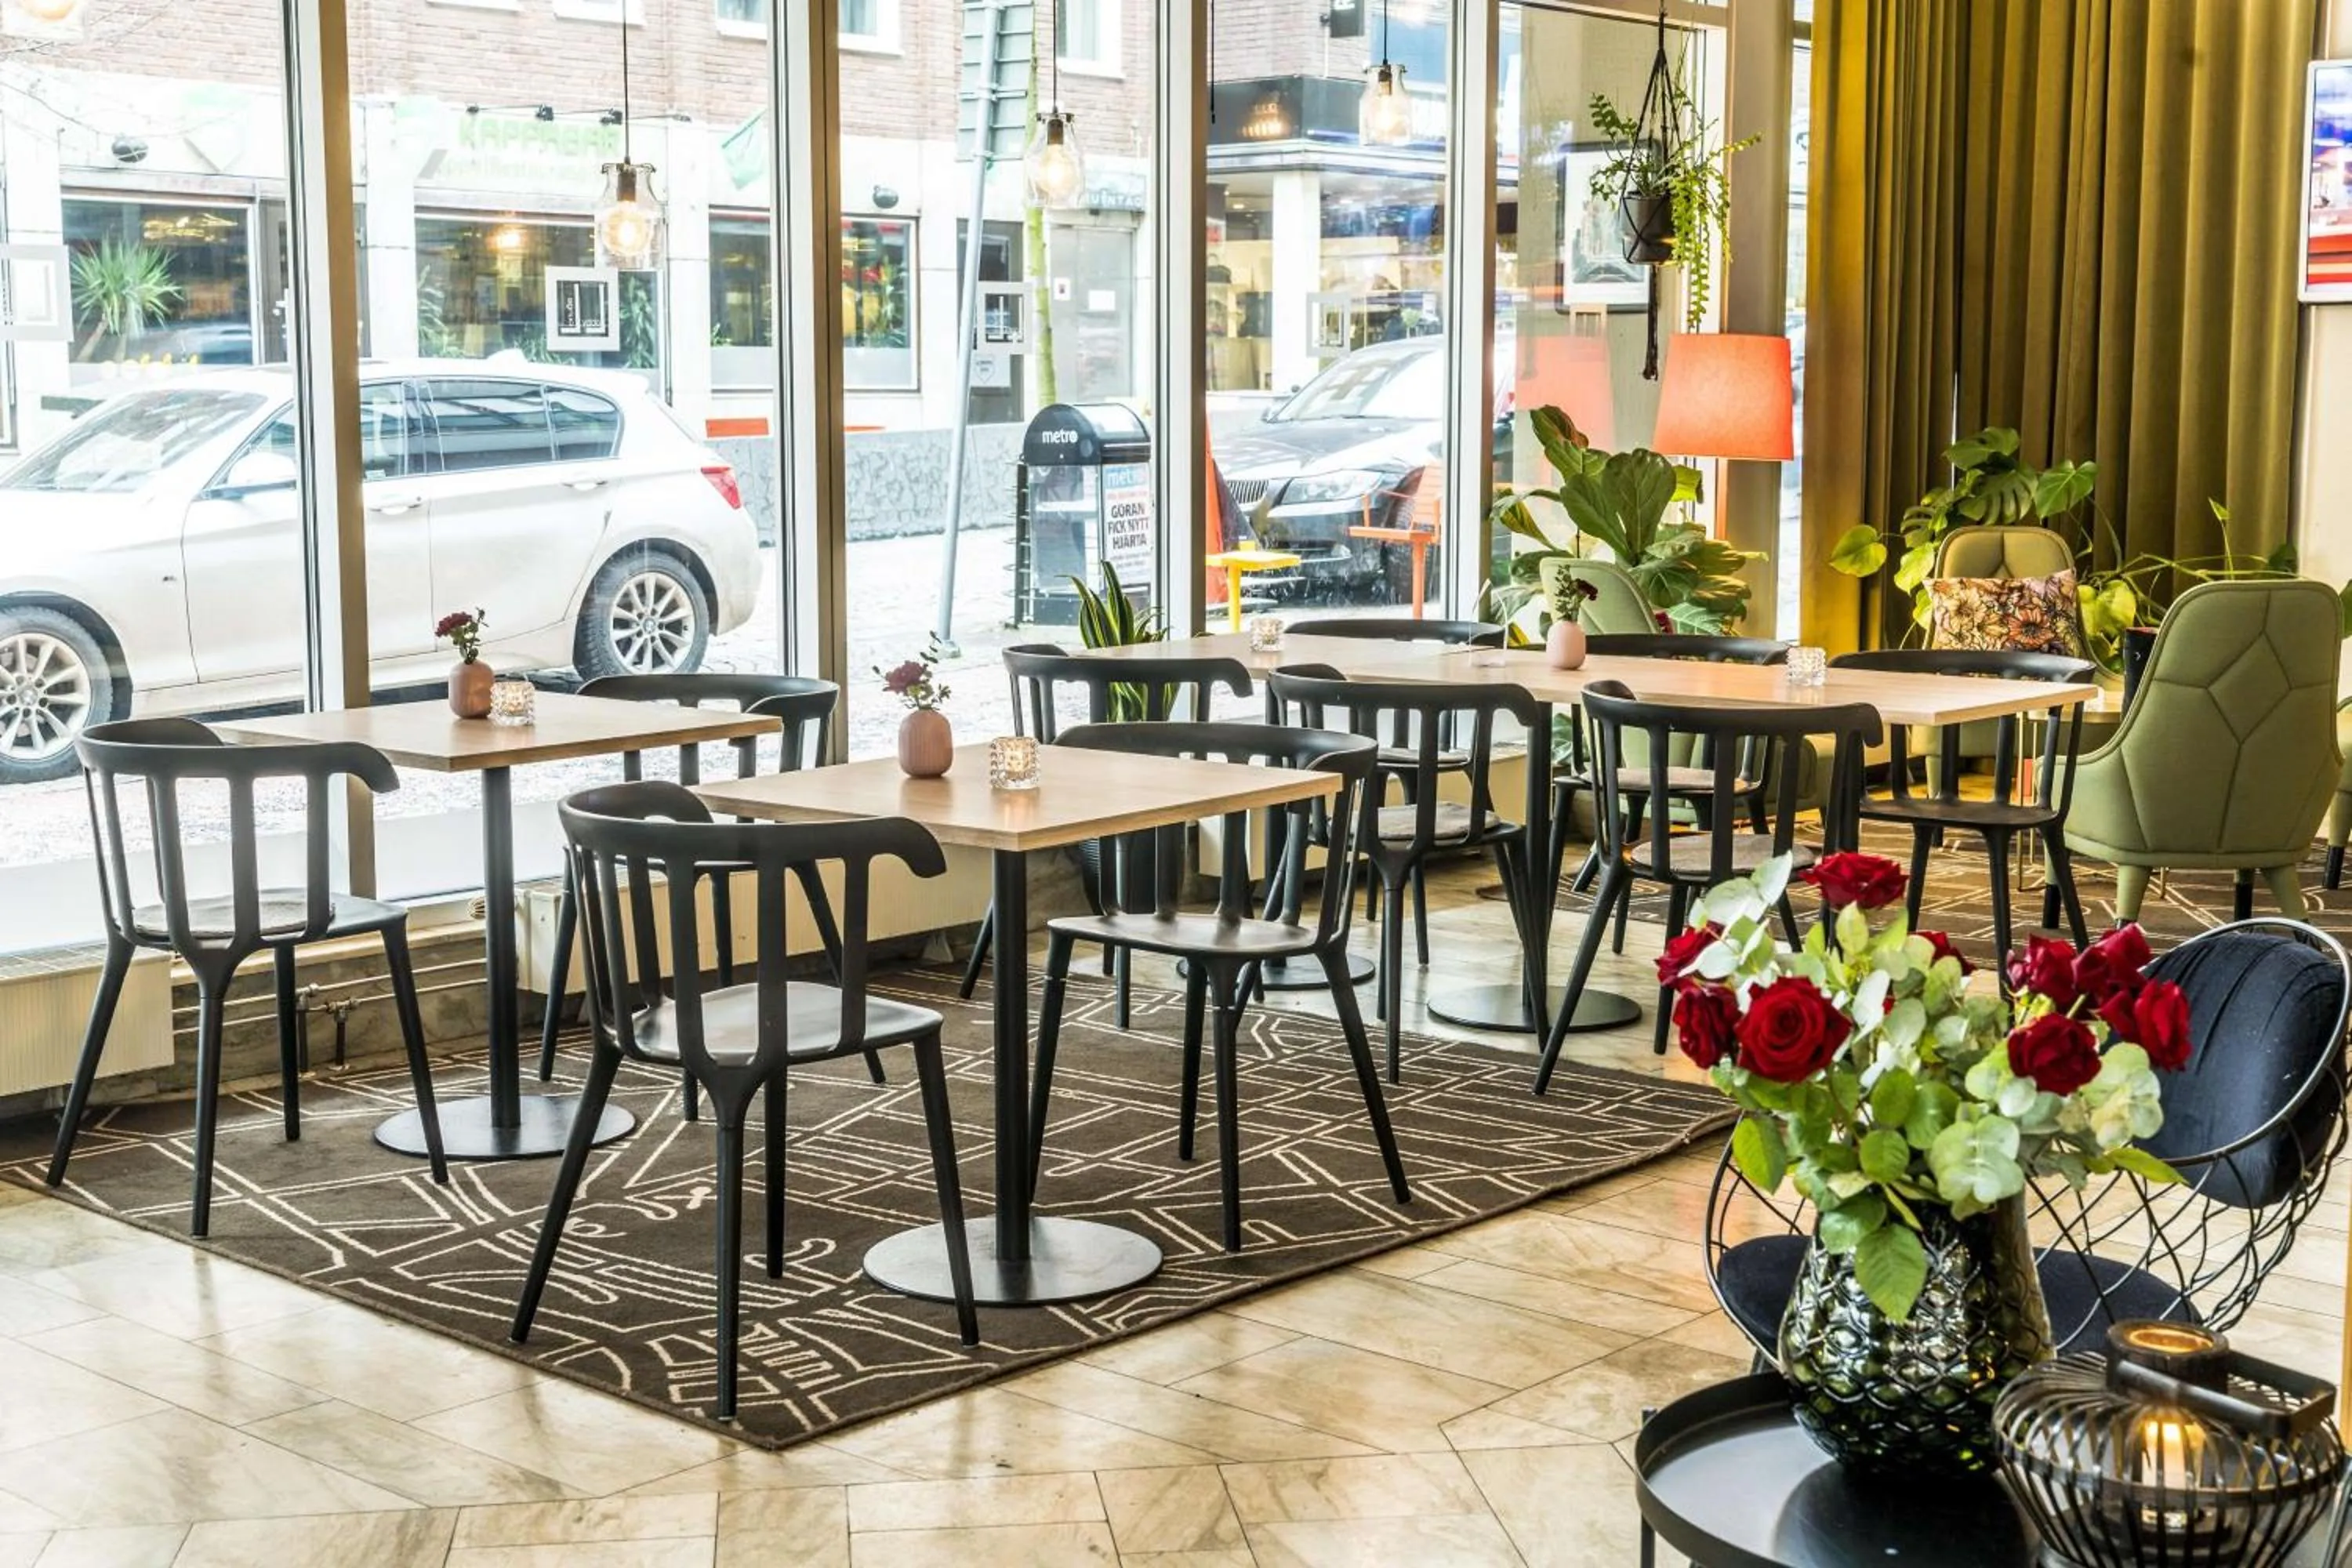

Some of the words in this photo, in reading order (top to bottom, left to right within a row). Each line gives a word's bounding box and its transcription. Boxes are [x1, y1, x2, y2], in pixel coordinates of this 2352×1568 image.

[1042, 428, 1079, 444] metro
[1106, 468, 1145, 487] met
[1127, 517, 1149, 533] NYTT
